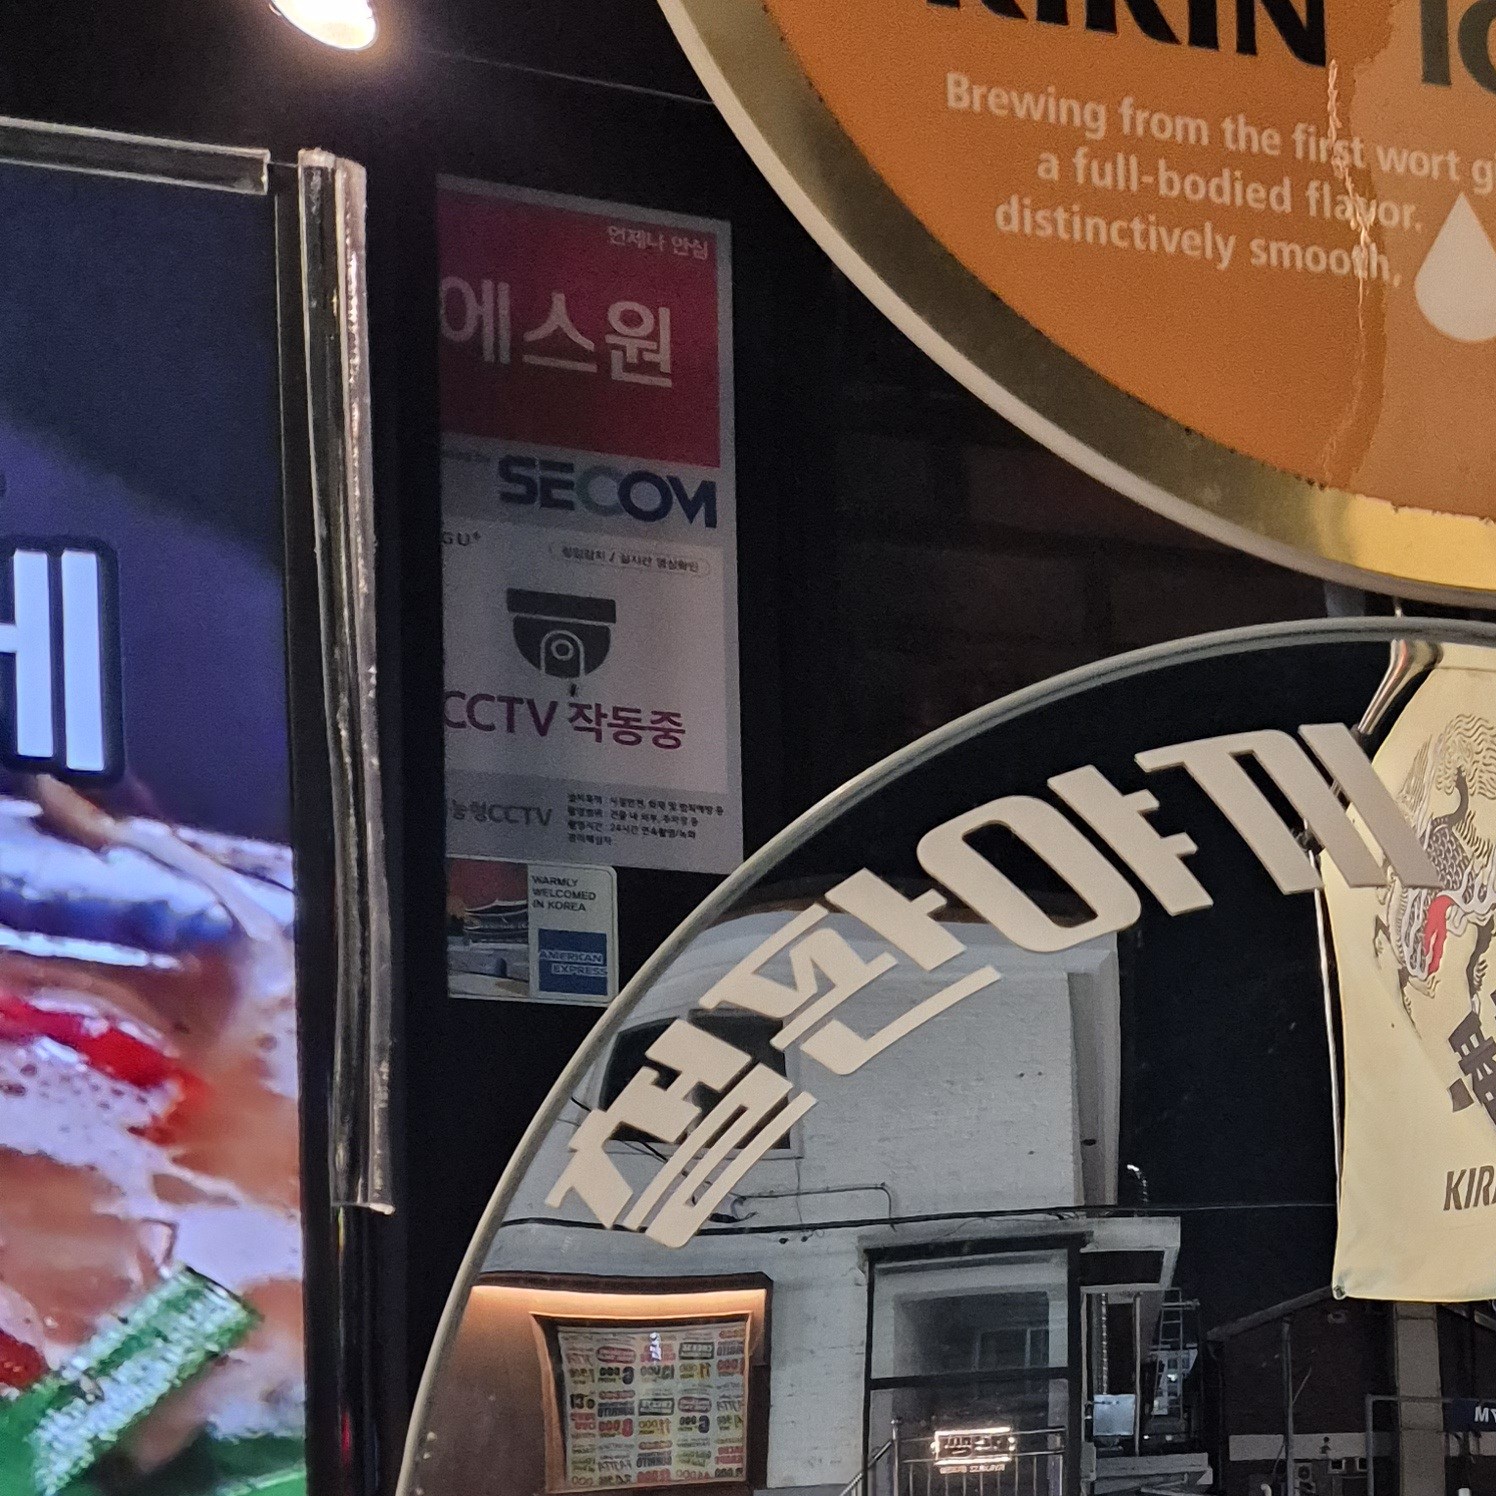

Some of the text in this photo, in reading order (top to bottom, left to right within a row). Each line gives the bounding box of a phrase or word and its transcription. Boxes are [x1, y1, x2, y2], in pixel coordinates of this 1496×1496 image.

[946, 71, 1105, 140] Brewing
[1118, 96, 1208, 145] from
[1222, 114, 1281, 157] the
[1292, 122, 1364, 169] first
[1377, 147, 1461, 182] wort
[1037, 150, 1059, 181] a
[1072, 146, 1292, 214] full-bodied
[1306, 180, 1422, 233] flavor.
[607, 226, 708, 260] 언제나 안심
[995, 195, 1236, 270] distinctively
[1249, 235, 1401, 287] smooth,
[439, 276, 673, 388] 에스원
[498, 454, 717, 528] SECOM
[444, 690, 686, 750] CCTV 작동중
[532, 874, 578, 888] WARMLY
[532, 888, 597, 902] WELCOMED
[532, 899, 587, 912] IN KOREA
[539, 949, 603, 965] AMERICAN
[551, 964, 608, 977] EXPRESS
